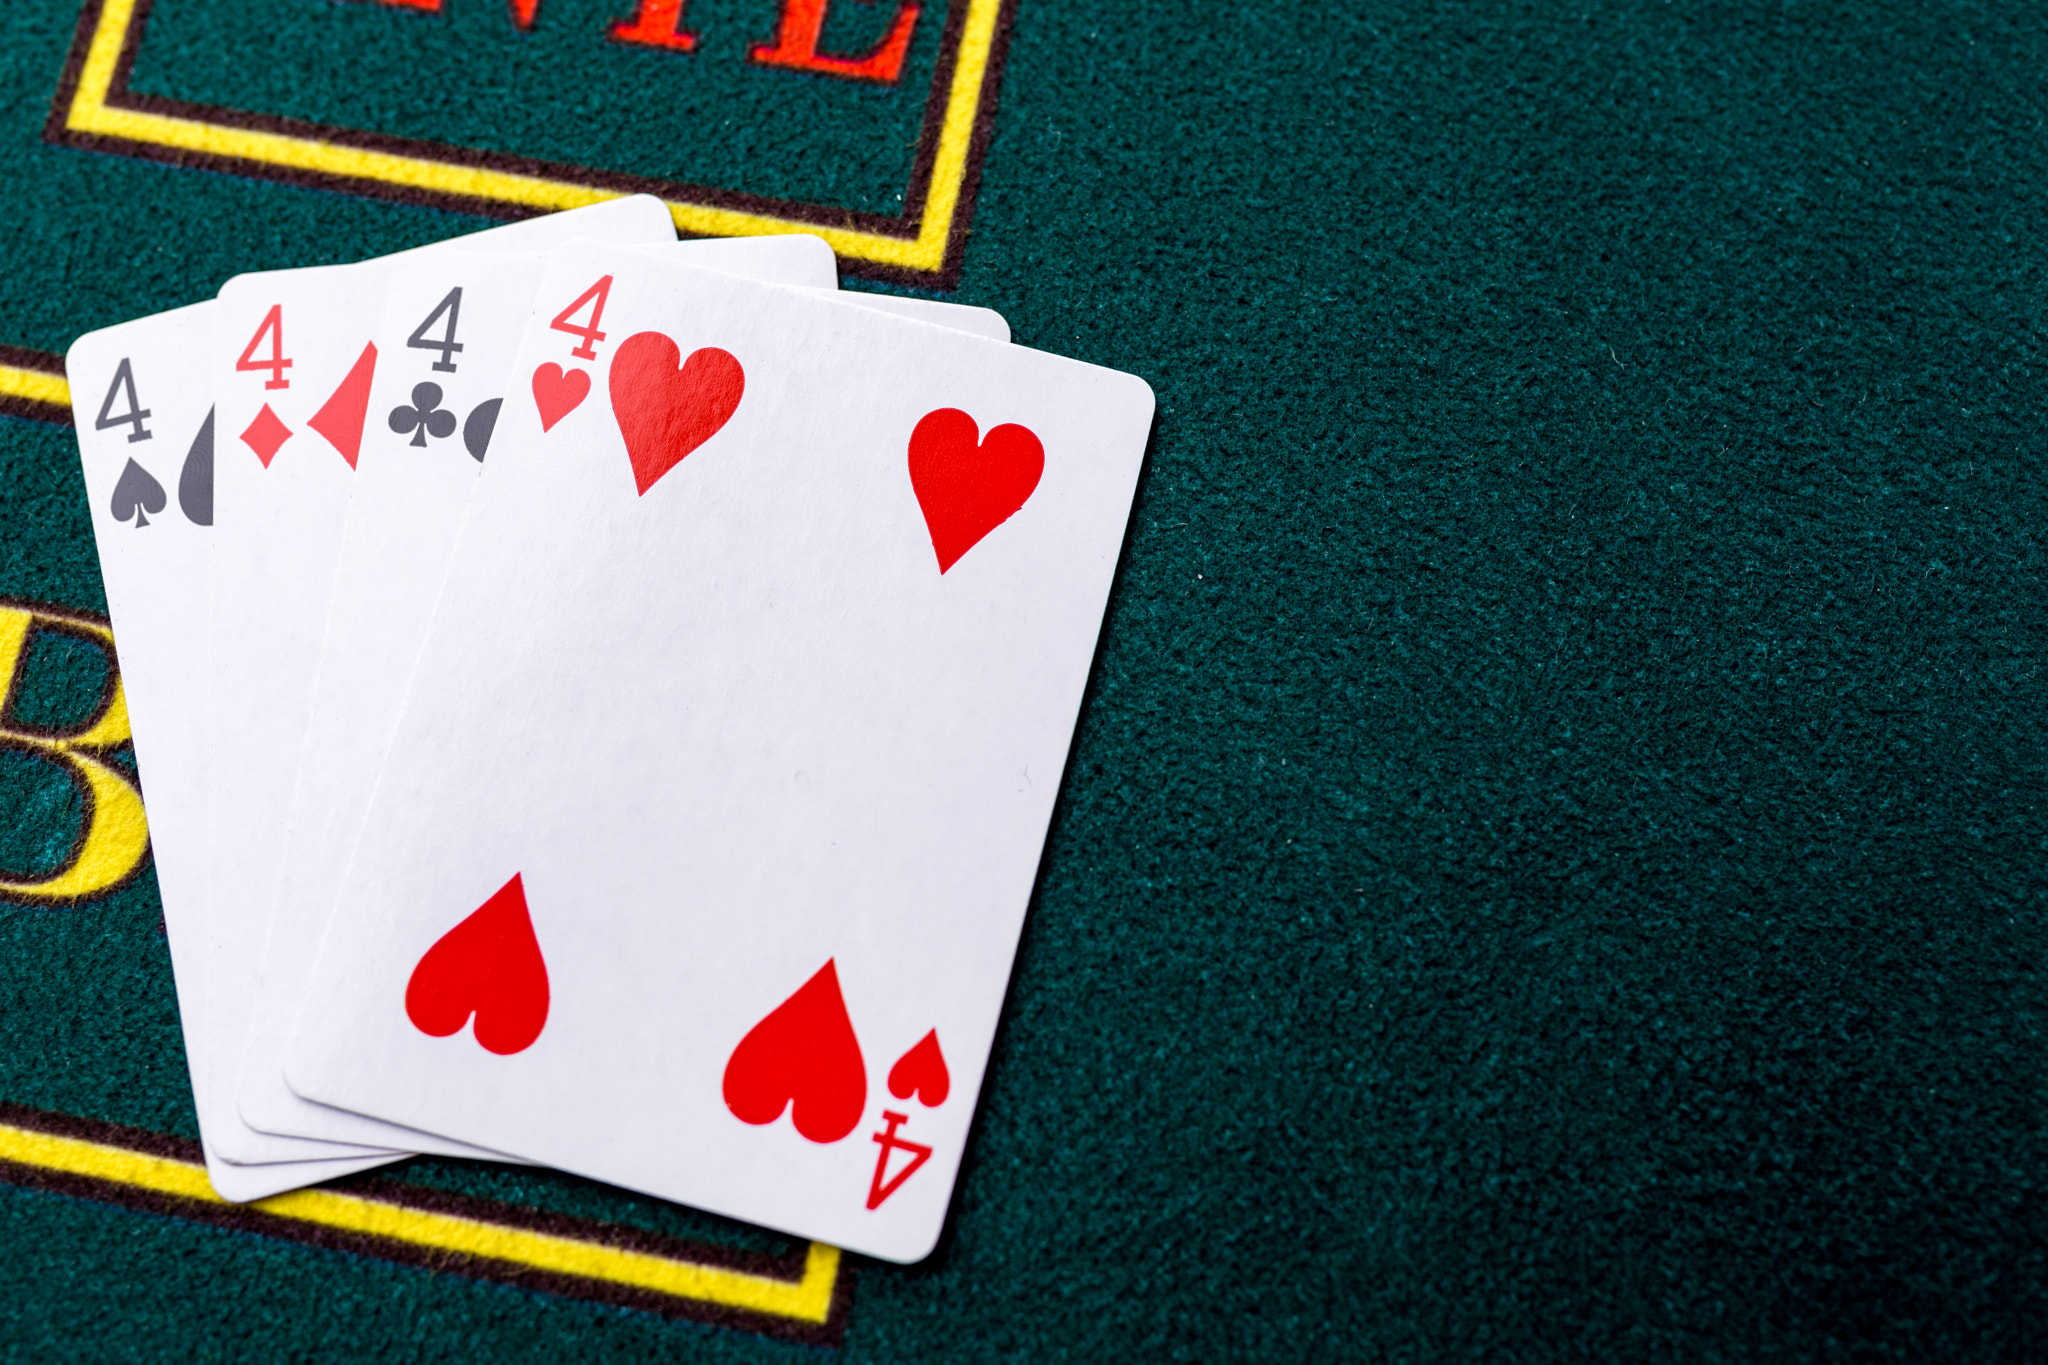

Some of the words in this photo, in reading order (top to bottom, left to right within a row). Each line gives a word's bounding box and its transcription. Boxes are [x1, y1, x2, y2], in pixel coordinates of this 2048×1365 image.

[235, 304, 293, 390] 4
[406, 286, 464, 373] 4
[549, 274, 614, 361] 4
[96, 357, 152, 443] 4
[866, 1110, 933, 1211] 4
